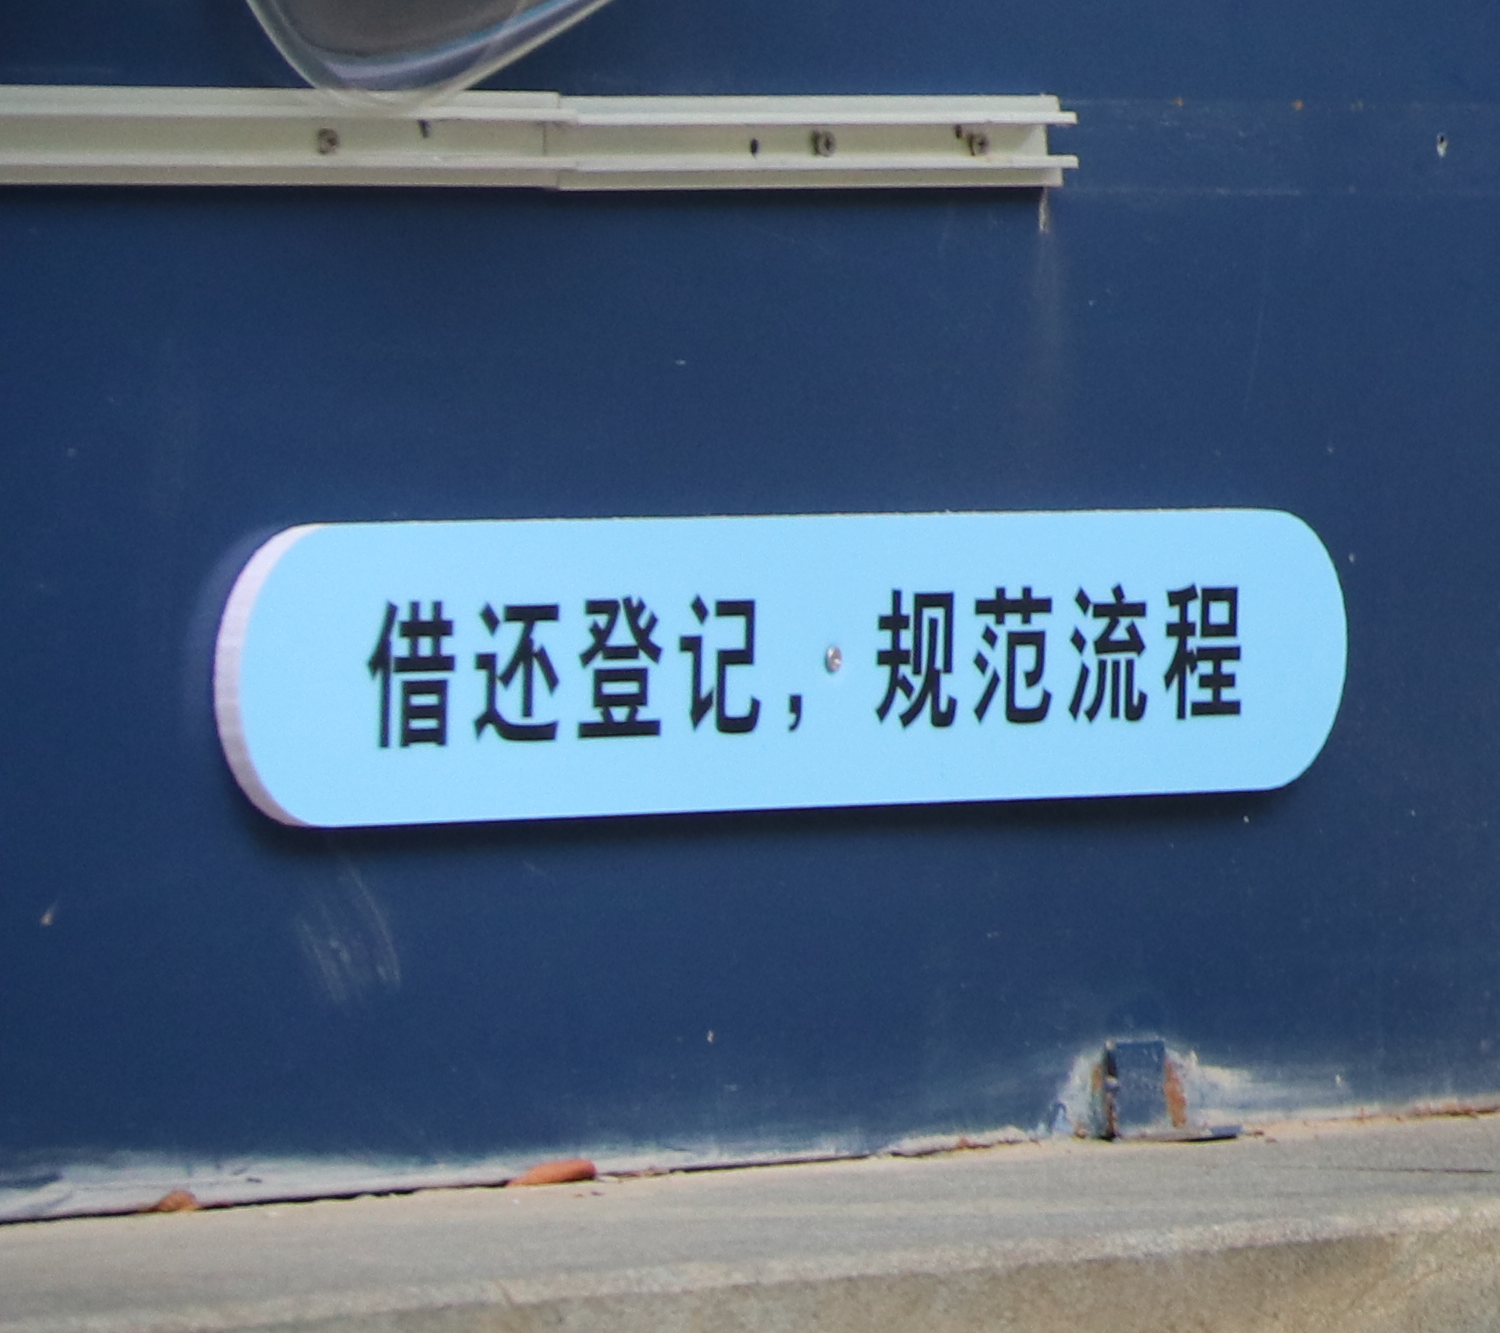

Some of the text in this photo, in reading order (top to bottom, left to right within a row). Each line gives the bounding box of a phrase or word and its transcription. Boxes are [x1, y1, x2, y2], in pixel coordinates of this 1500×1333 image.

[366, 583, 1243, 749] 借还登记，规范流程
